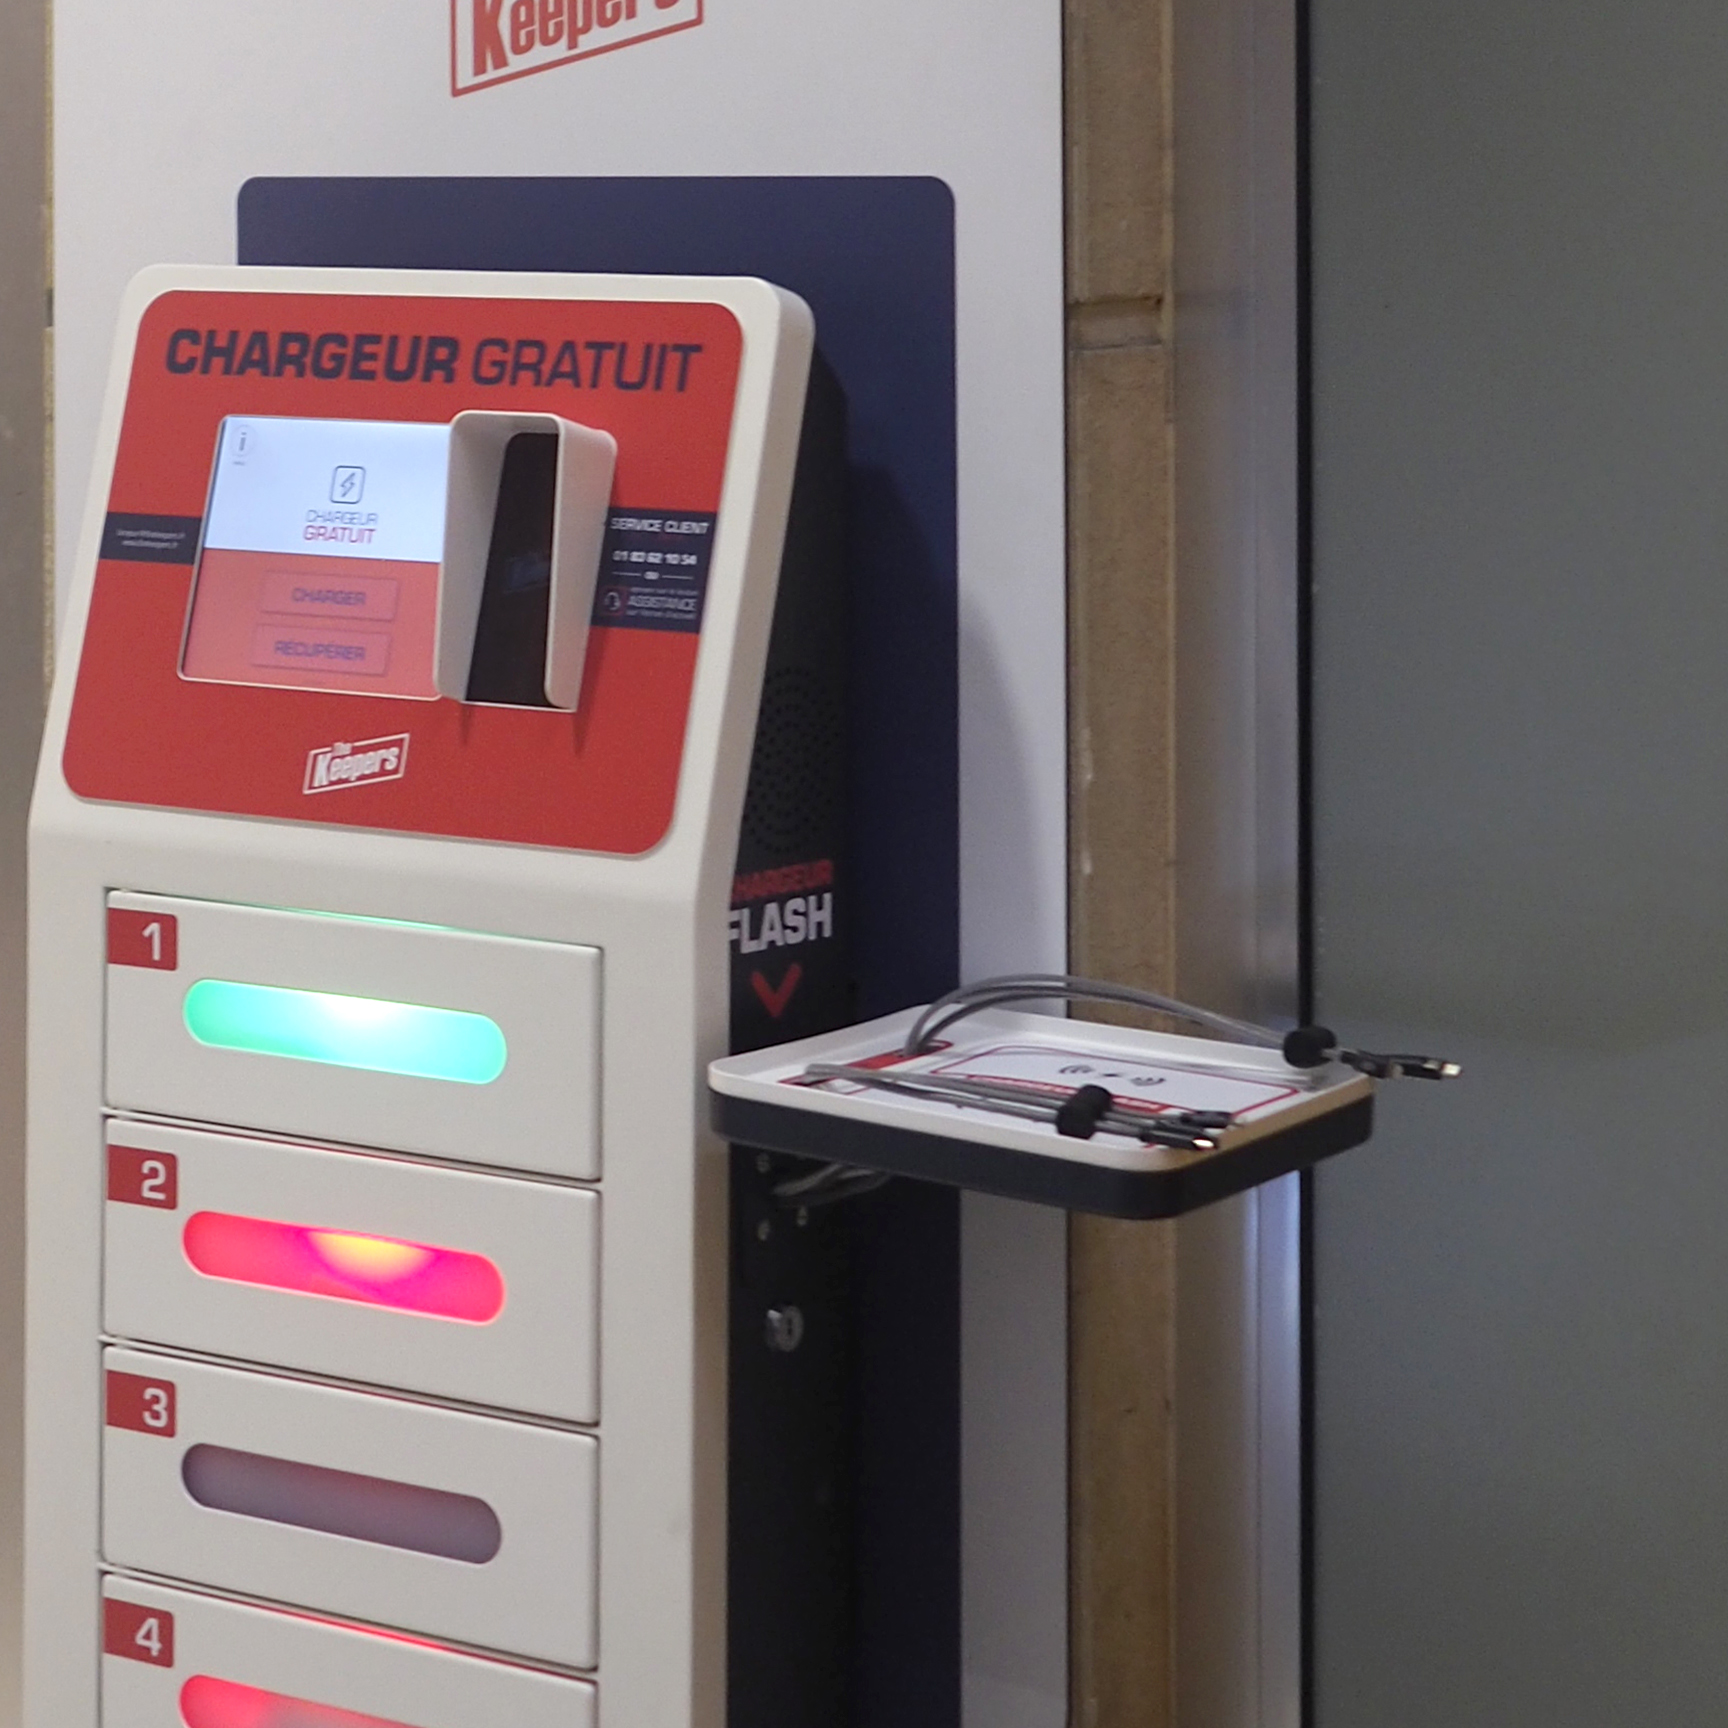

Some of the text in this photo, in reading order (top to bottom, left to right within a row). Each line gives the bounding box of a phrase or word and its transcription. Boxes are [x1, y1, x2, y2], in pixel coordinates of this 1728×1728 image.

[166, 328, 703, 393] CHARGEUR GRATUIT
[302, 525, 377, 544] GRATUIT
[305, 509, 379, 526] CHARGEUR
[610, 517, 710, 534] SERVICE CLIENT
[291, 587, 367, 607] CHARGER
[274, 638, 366, 661] RÉCUPÉRER
[313, 747, 400, 788] Keepers
[730, 858, 834, 906] HARGEUR
[141, 922, 162, 962] 1
[729, 892, 834, 955] FLASH
[140, 1160, 168, 1202] 2
[141, 1387, 169, 1429] 3
[135, 1617, 163, 1657] 4
